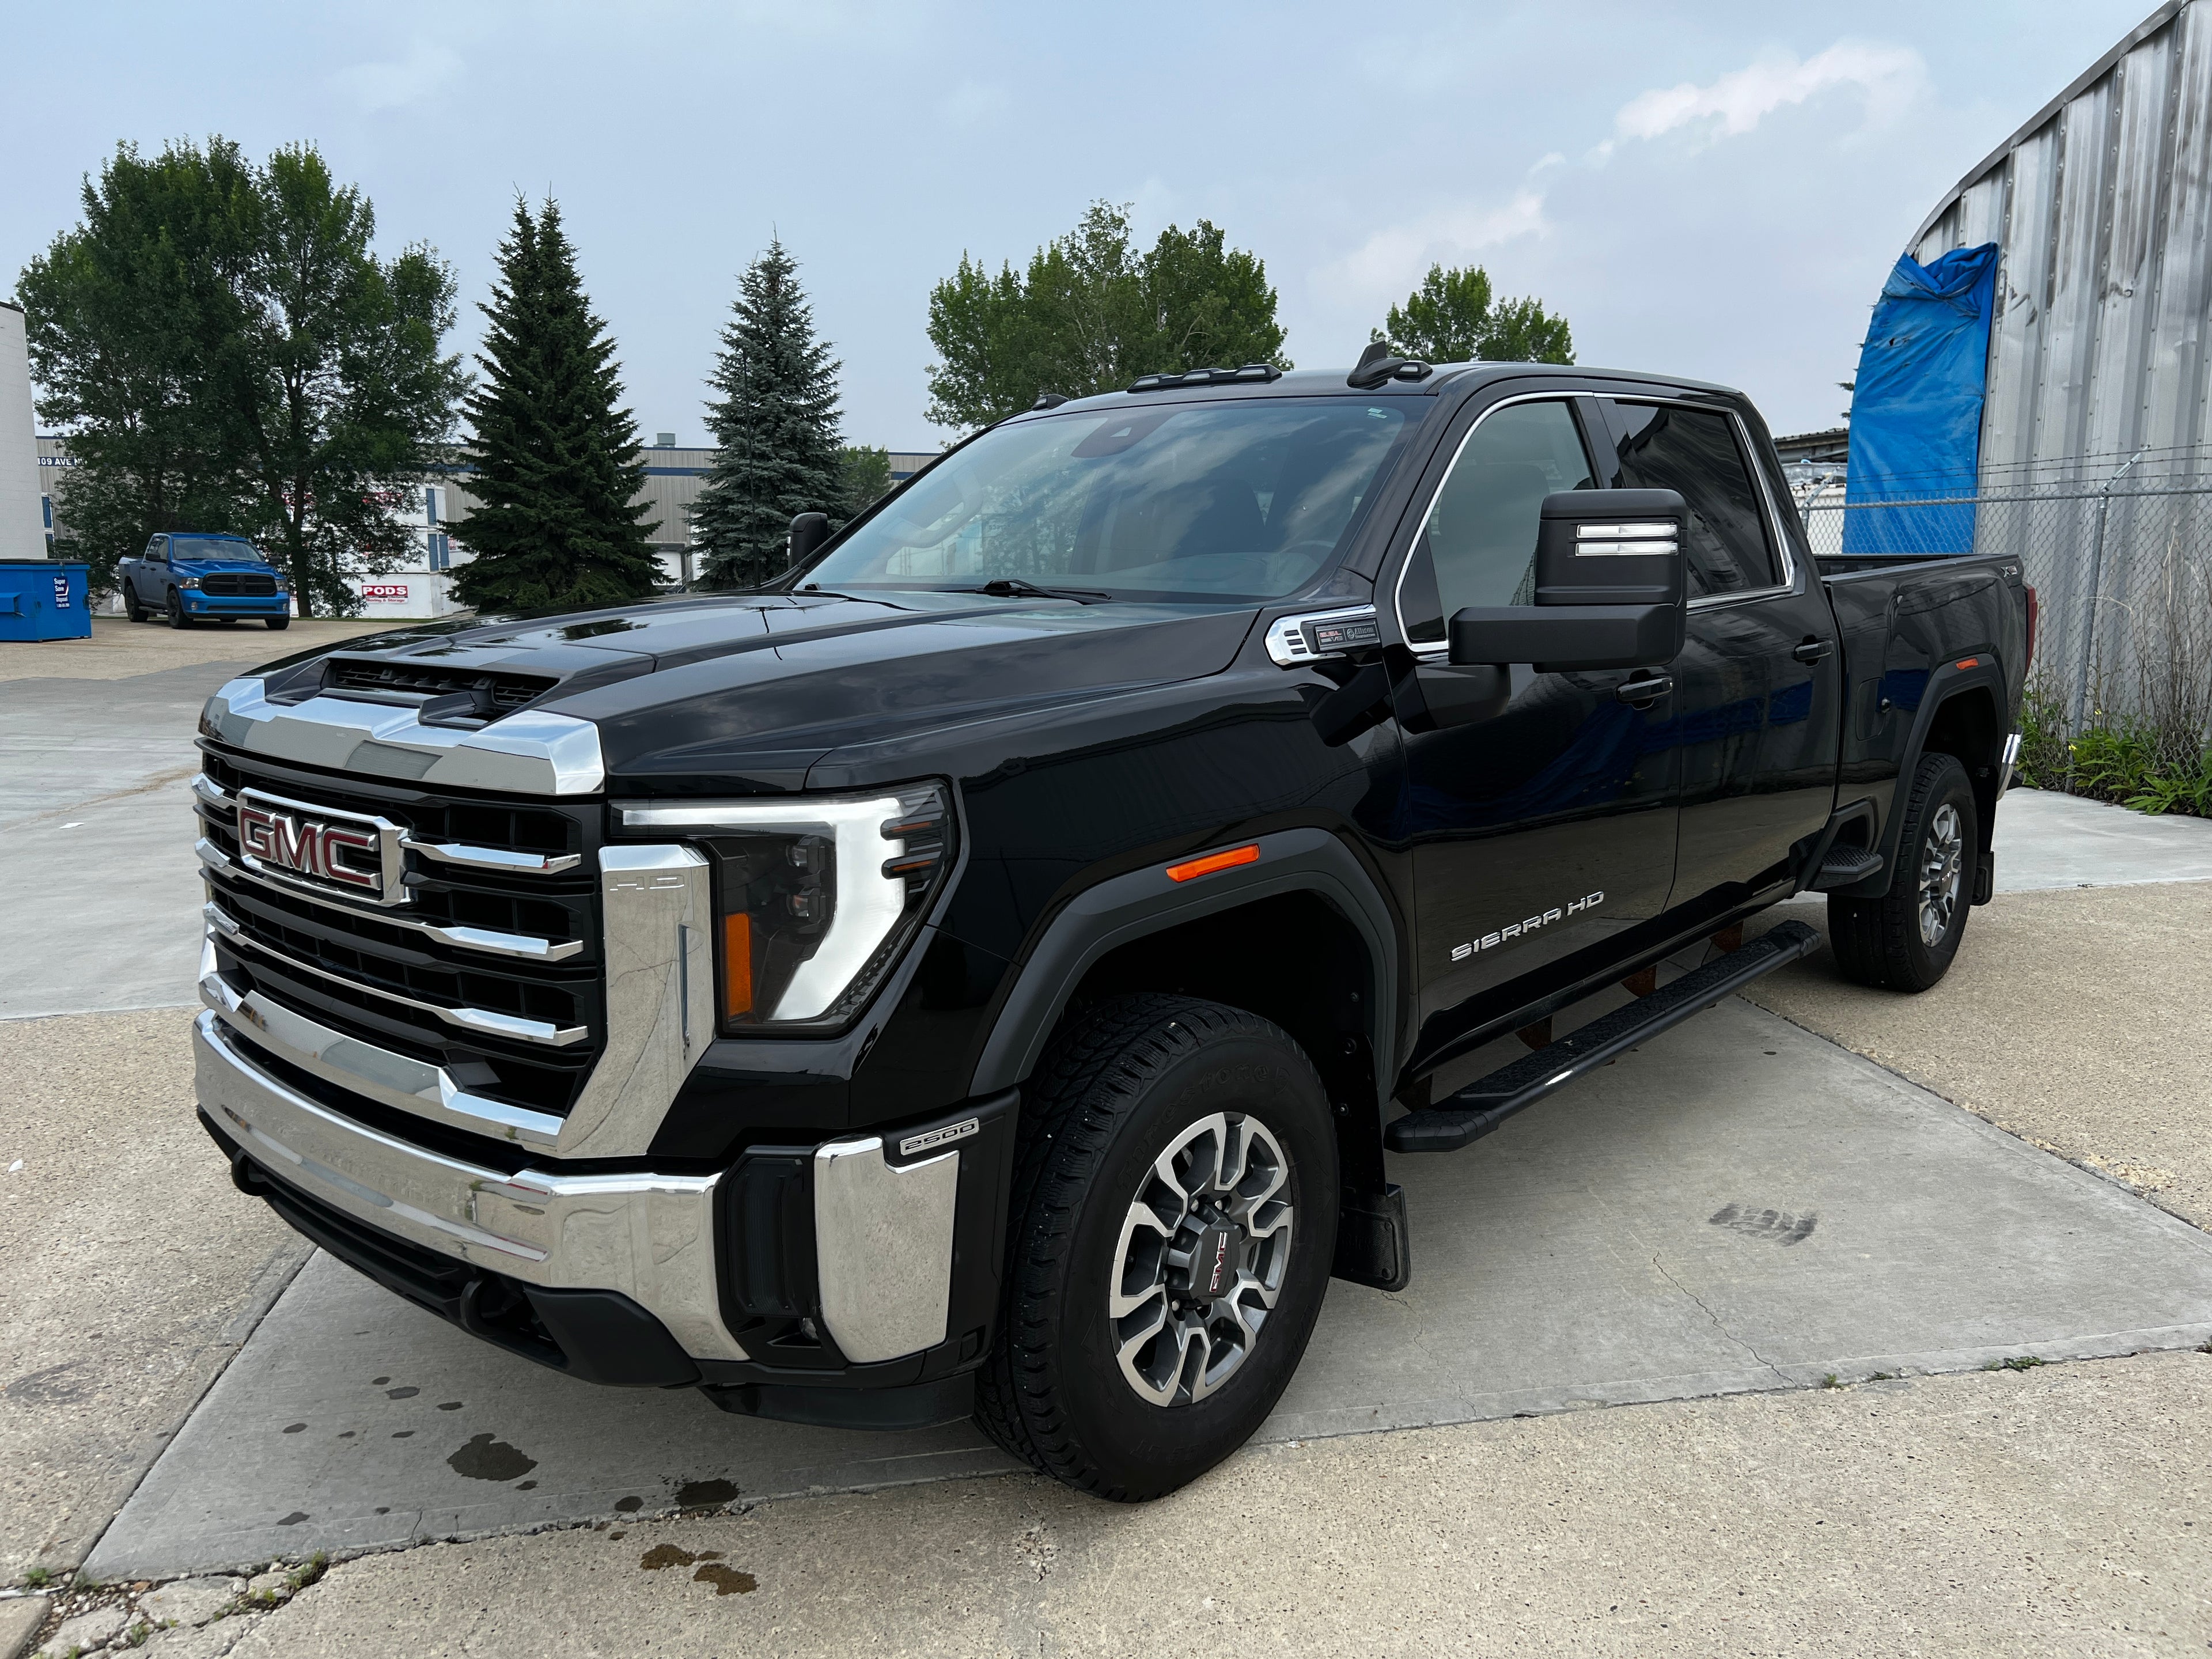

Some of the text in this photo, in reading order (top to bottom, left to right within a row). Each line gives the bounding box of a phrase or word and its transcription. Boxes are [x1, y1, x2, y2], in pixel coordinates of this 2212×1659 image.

[37, 457, 52, 465] 109
[363, 586, 407, 595] PODS
[1354, 627, 1374, 635] Allison
[240, 806, 381, 891] GMC
[609, 874, 685, 891] HD
[1450, 891, 1604, 962] SIERRA HD
[905, 1123, 975, 1150] 2500
[1116, 1063, 1268, 1191] Firestone
[1209, 1232, 1228, 1293] GMC
